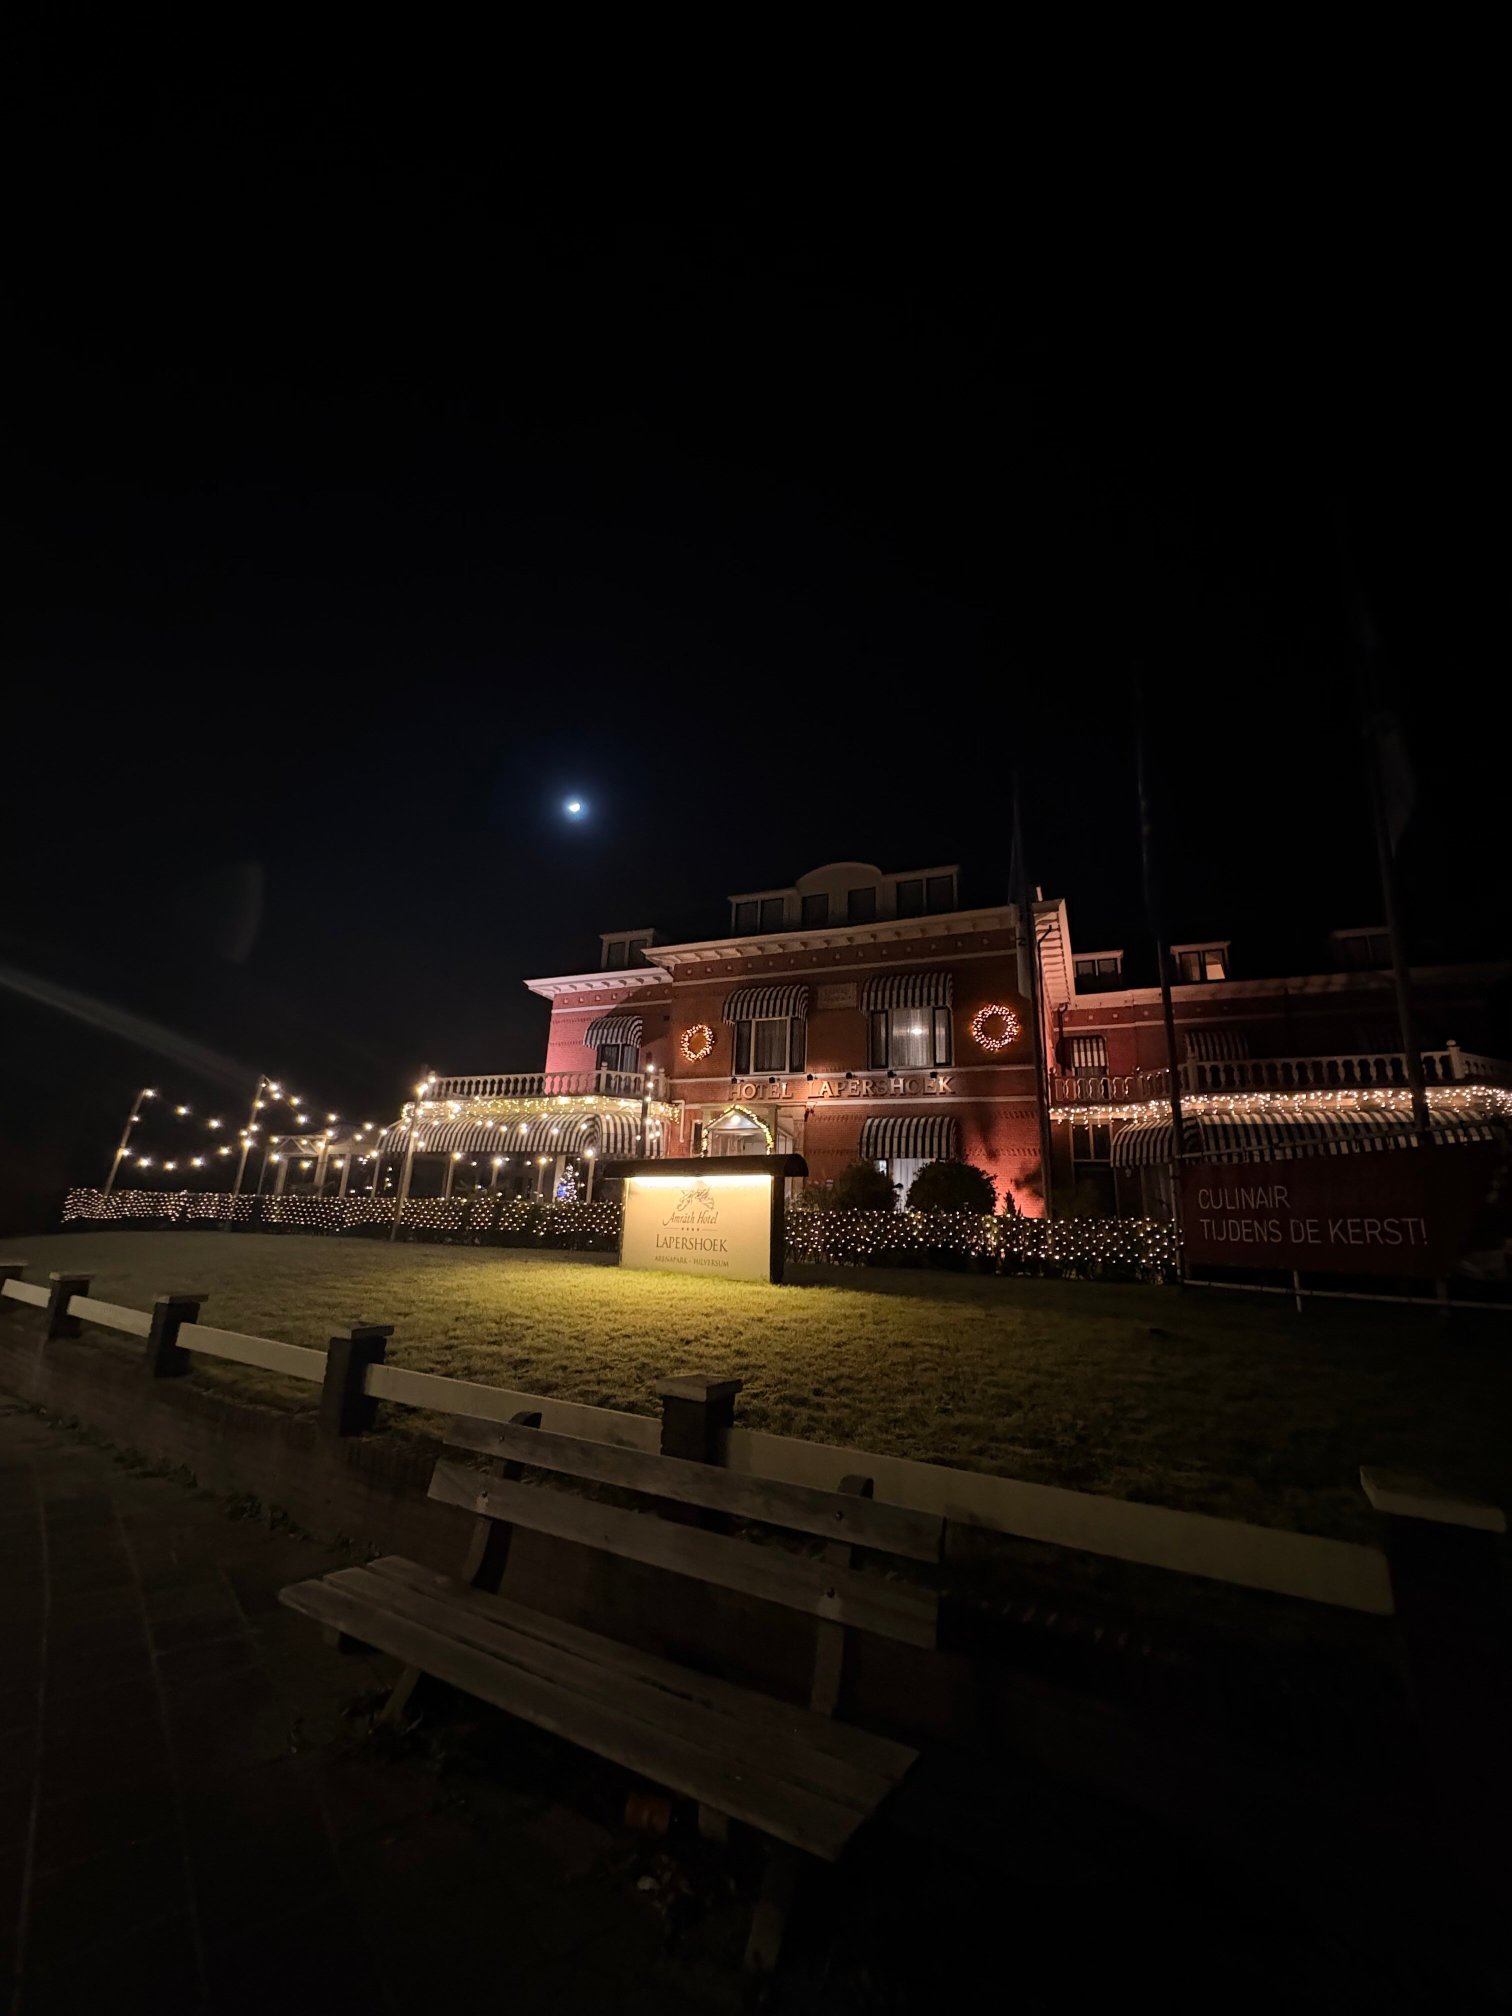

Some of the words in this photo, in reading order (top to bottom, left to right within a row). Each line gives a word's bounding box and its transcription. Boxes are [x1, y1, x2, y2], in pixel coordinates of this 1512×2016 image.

[728, 1082, 793, 1100] HOTEL
[808, 1076, 955, 1099] LAPERSHOEK
[1198, 1185, 1291, 1210] CULINAIR
[697, 1210, 719, 1224] Hotel
[656, 1233, 728, 1253] LAPERSHOEK
[1200, 1218, 1283, 1243] TIJDENS
[1290, 1219, 1322, 1244] DE
[1328, 1218, 1429, 1246] KERST!
